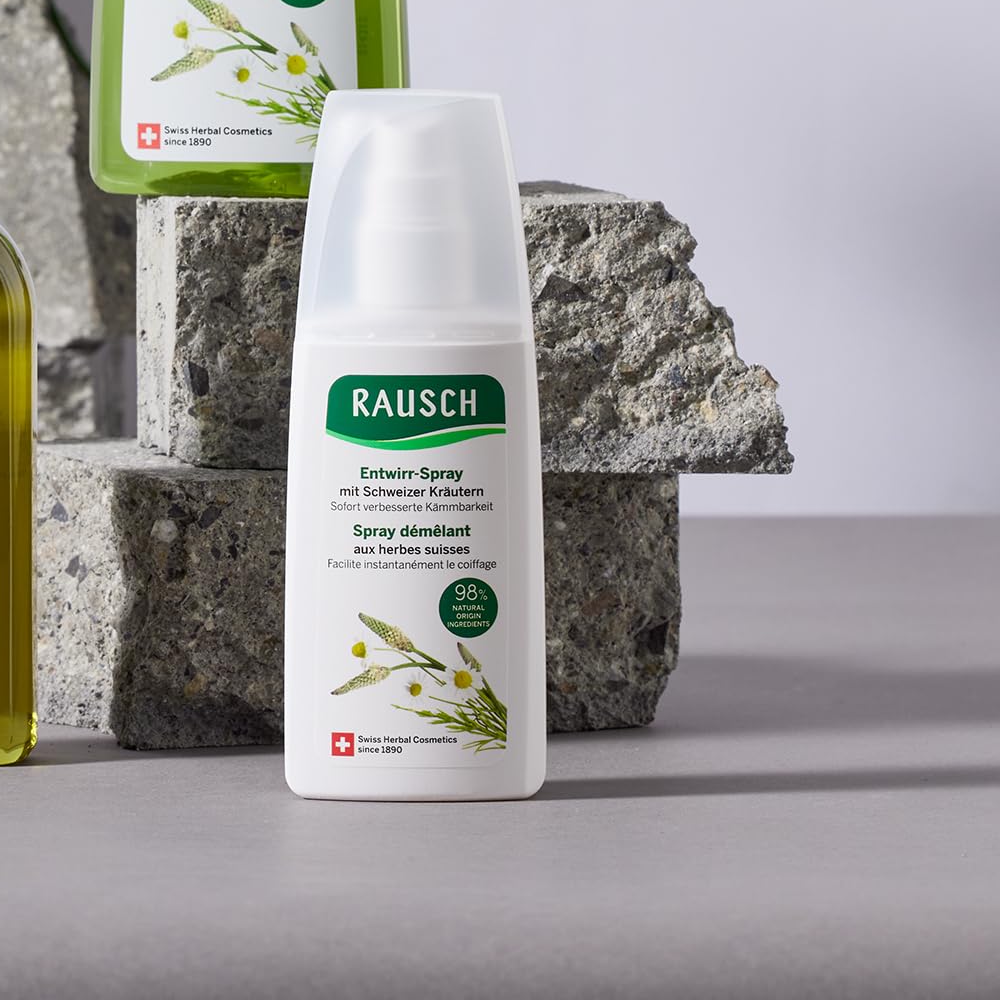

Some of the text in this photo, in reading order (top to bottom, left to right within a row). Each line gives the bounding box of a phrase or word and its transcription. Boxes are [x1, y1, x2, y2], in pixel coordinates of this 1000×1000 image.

[164, 126, 273, 136] Swiss Herbal Cosmetics
[164, 138, 212, 146] since 1890
[352, 388, 477, 418] RAUSCH
[360, 467, 464, 482] Entwirr-Spray
[339, 486, 484, 497] mit Schweizer Kräutern
[330, 502, 494, 512] Sofort verbesserte Kämmbarkeit
[352, 524, 471, 540] Spray démêlant
[353, 544, 470, 555] aux herbes suisses
[327, 559, 497, 571] Facilite instantanément le coiffage
[455, 584, 488, 601] 98%
[357, 735, 458, 744] Swiss Herbal Cosmetics
[381, 746, 403, 754] 1890
